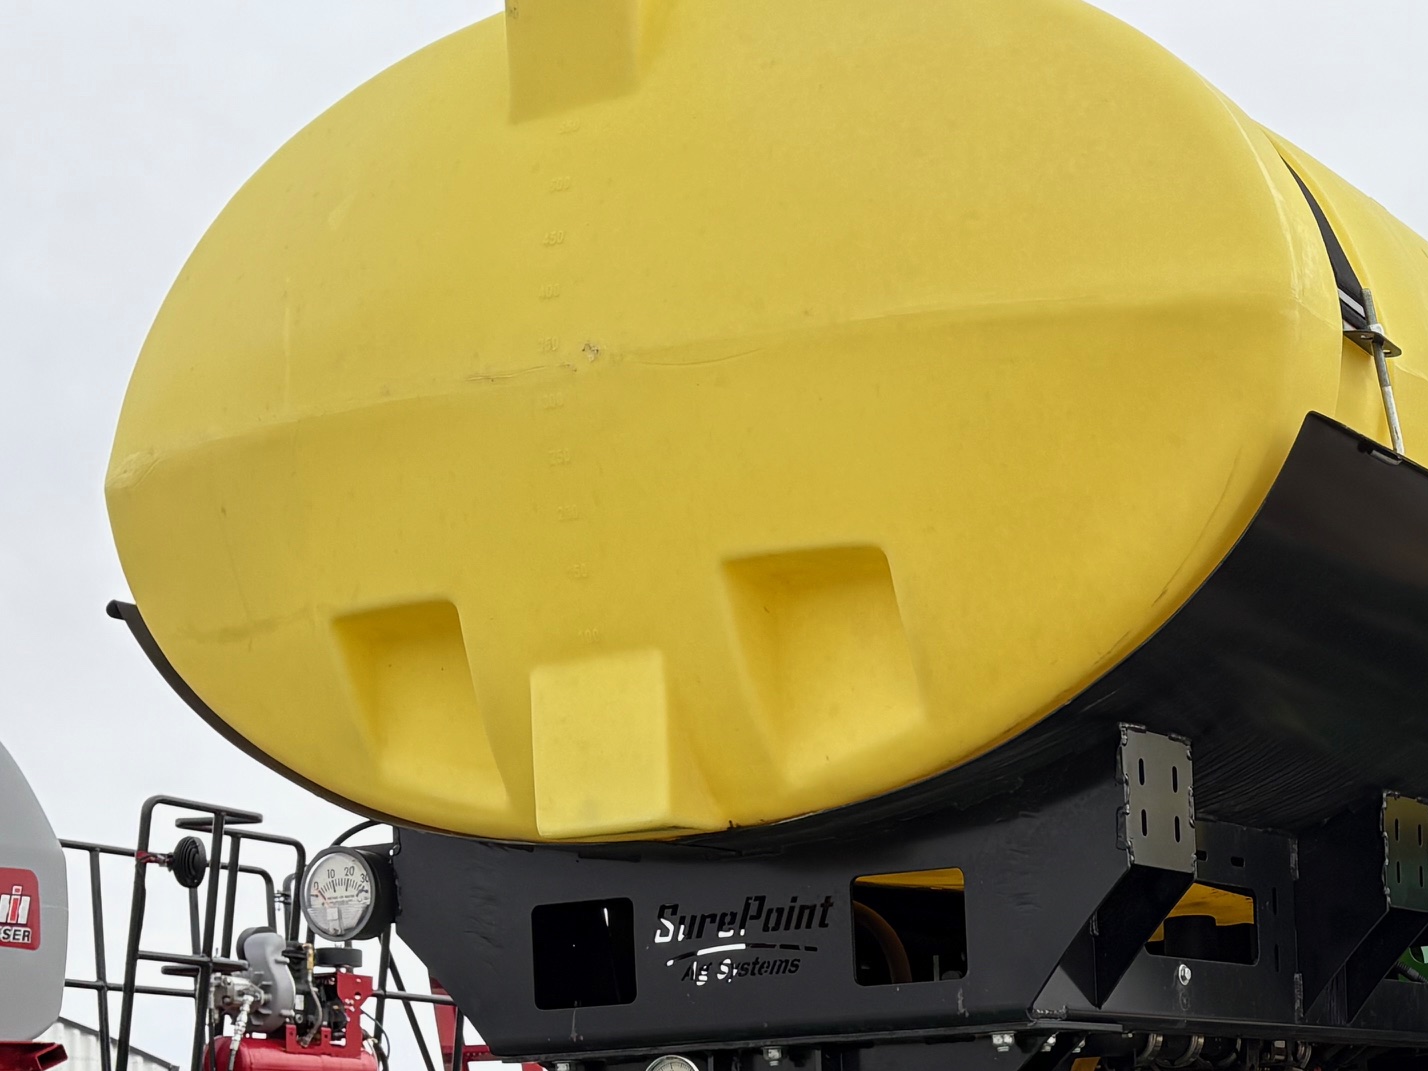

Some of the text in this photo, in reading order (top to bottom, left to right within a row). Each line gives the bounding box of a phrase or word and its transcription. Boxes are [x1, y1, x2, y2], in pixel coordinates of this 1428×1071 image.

[327, 868, 336, 879] 10
[344, 866, 355, 877] 20
[654, 895, 834, 943] SurePoint
[0, 928, 31, 942] SER
[681, 957, 801, 986] Ag Systems
